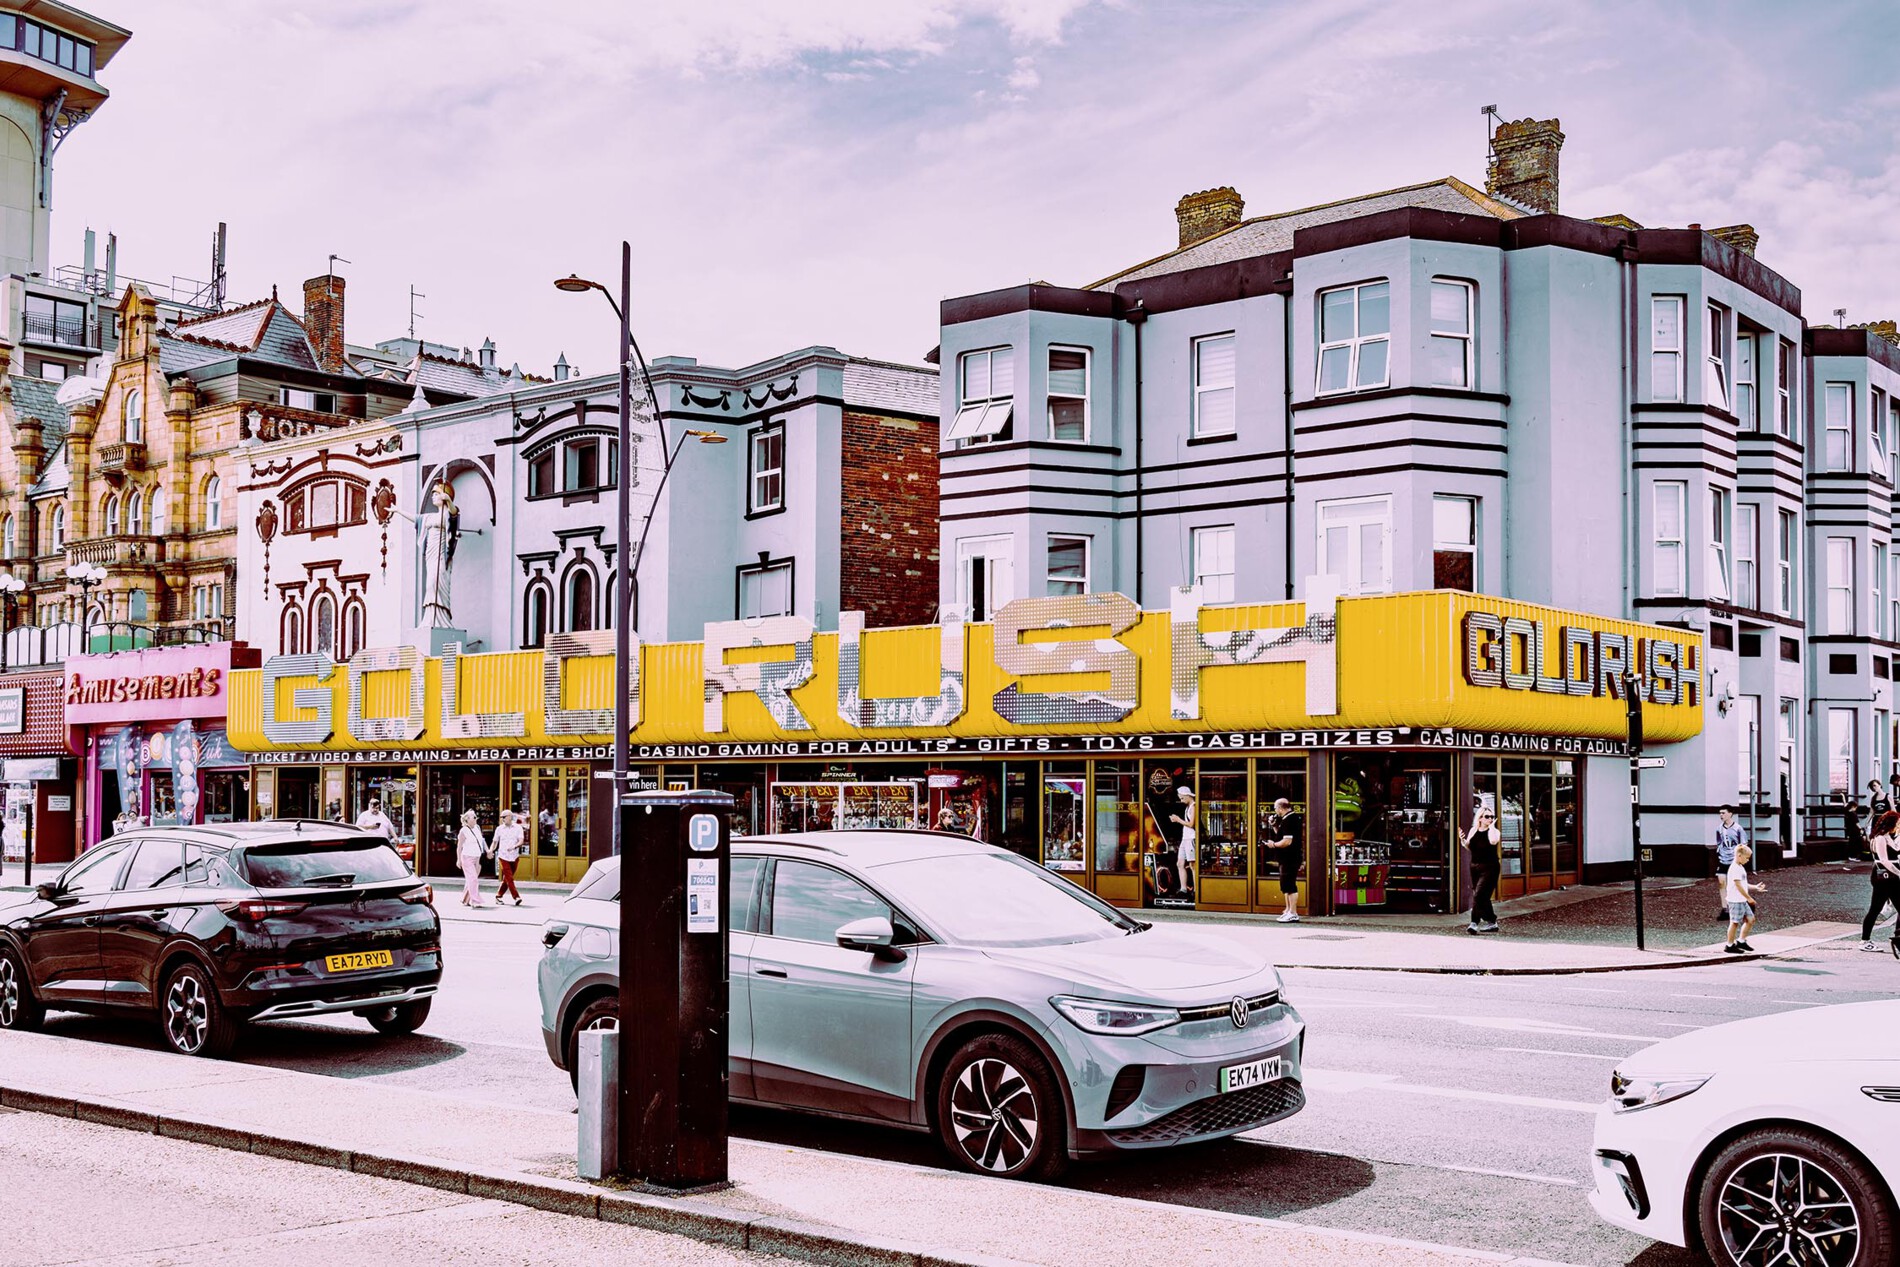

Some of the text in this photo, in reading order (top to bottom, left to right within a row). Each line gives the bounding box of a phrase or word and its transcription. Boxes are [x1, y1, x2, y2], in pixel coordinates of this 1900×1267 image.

[263, 575, 1340, 743] GOLD RUSH
[1462, 611, 1701, 707] GOLDRUSH
[67, 667, 220, 704] Amusements
[252, 753, 296, 763] TICKET
[311, 752, 350, 762] VIDEO
[355, 752, 364, 761] &
[370, 752, 386, 761] 2P
[392, 750, 450, 761] GAMING
[467, 749, 510, 760] MEGA
[517, 748, 565, 759] PRIZE
[639, 745, 710, 757] CASINO
[718, 743, 800, 756] GAMING
[808, 742, 850, 754] FOR
[859, 740, 949, 753] ADULTS
[978, 738, 1051, 751] GIFTS
[1082, 736, 1154, 750] TOYS
[1188, 733, 1266, 748] CASH
[1280, 731, 1394, 746] PRIZES
[1420, 730, 1484, 747] CASINO
[1490, 734, 1549, 751] GAMING
[1555, 739, 1582, 753] FOR
[641, 779, 657, 789] here
[697, 820, 712, 845] P
[331, 952, 388, 970] EA72 RYD
[1229, 1058, 1280, 1088] EK74 VXW
[1783, 1216, 1793, 1232] KIA
